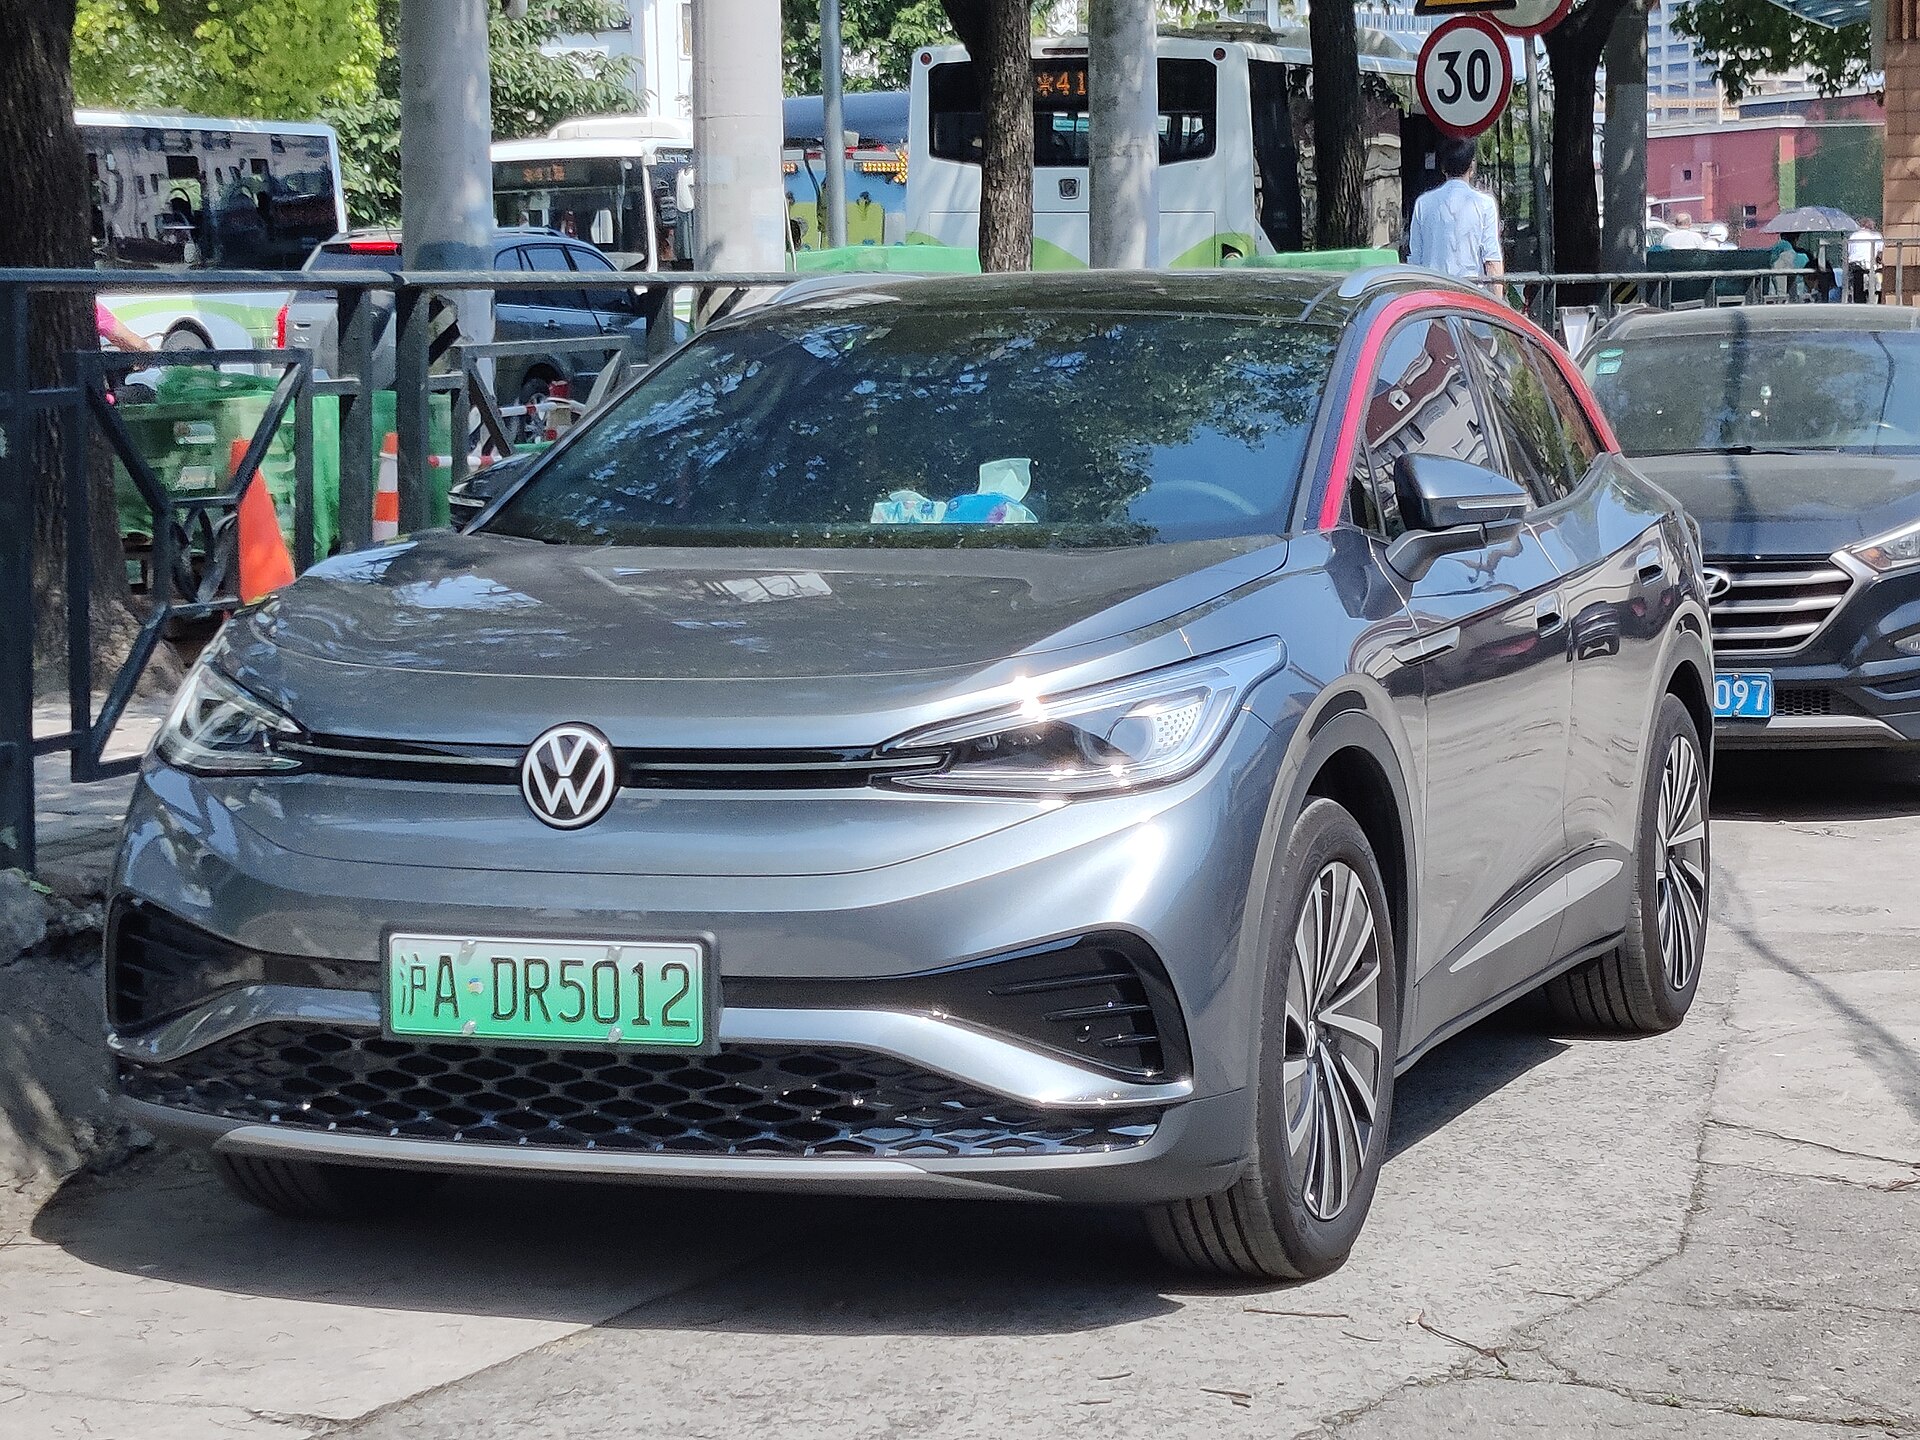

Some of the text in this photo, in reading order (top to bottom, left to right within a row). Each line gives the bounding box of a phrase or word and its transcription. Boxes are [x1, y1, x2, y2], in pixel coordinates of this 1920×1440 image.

[1436, 48, 1491, 105] 30
[529, 735, 608, 815] VW
[490, 955, 691, 1028] DR5012
